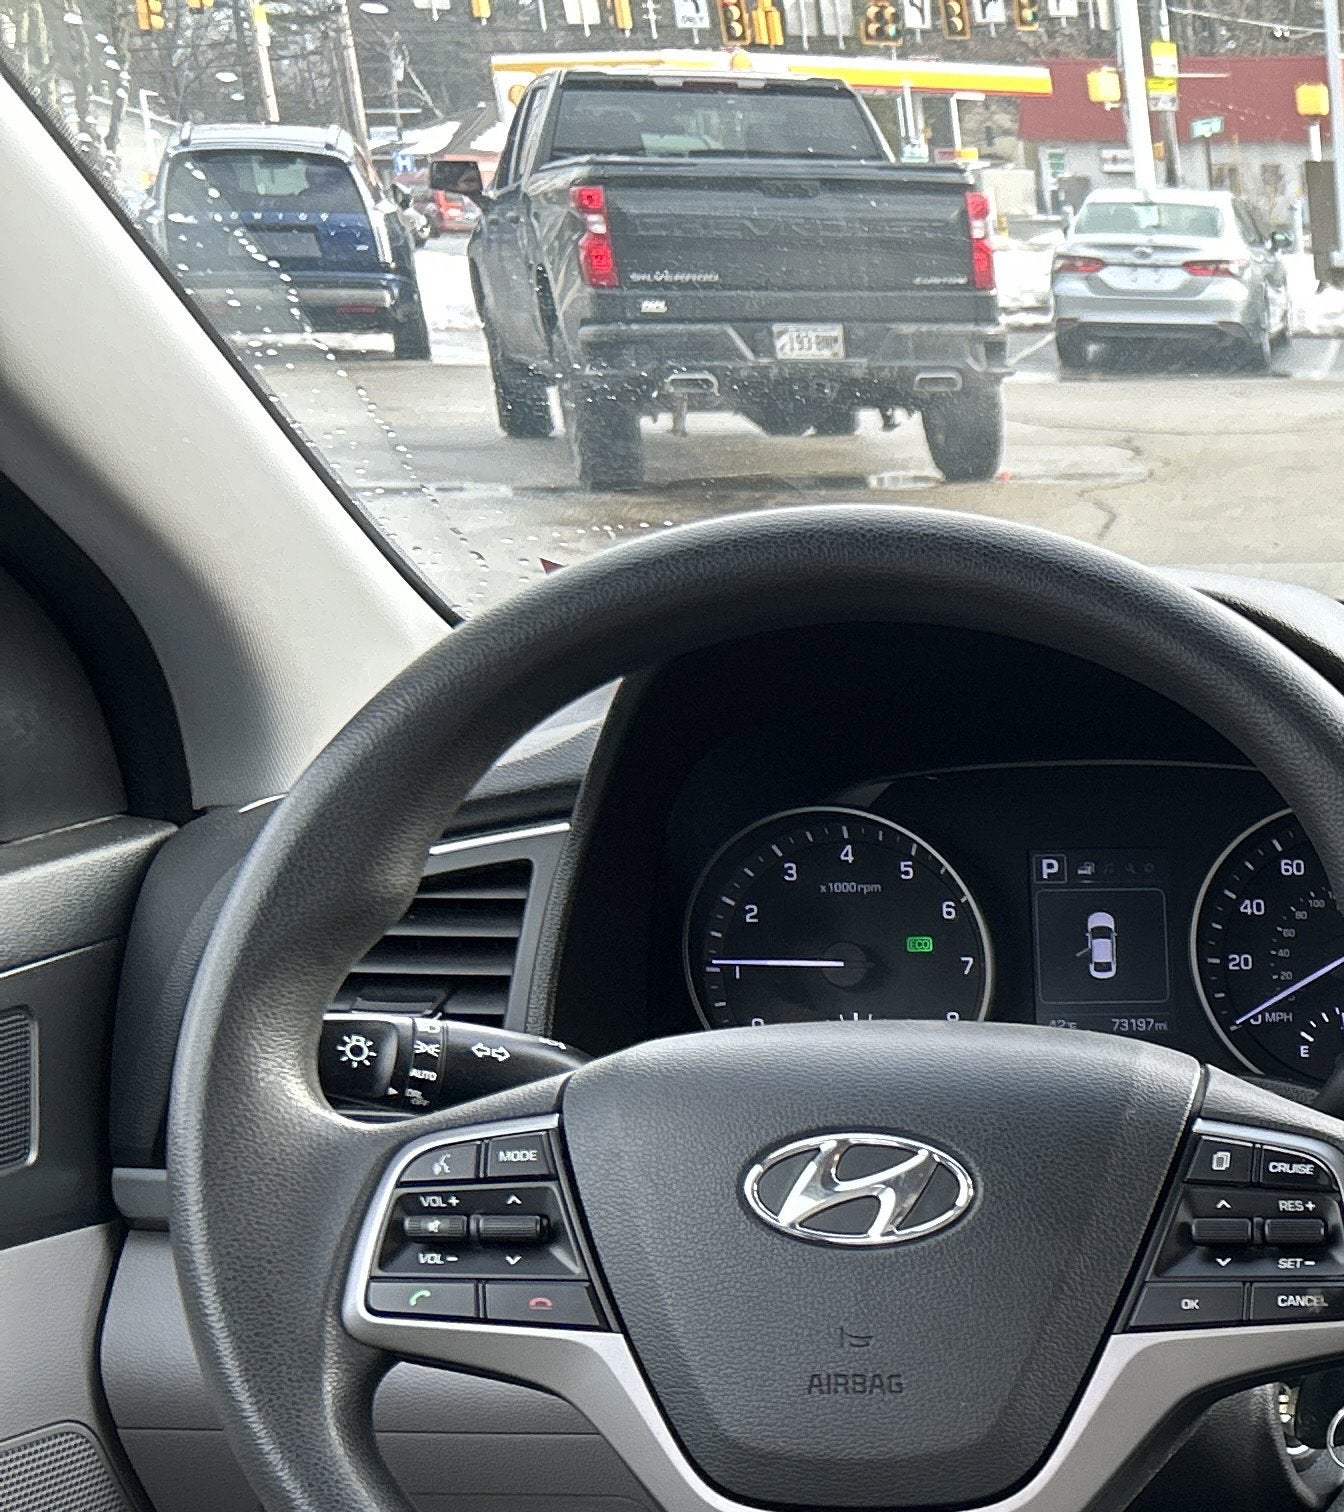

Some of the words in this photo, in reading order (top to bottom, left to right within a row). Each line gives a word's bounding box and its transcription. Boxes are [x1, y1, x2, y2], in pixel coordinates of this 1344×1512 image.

[840, 845, 854, 863] 4
[784, 863, 797, 880] 3
[900, 862, 913, 879] 5
[1041, 859, 1059, 879] P
[1280, 860, 1305, 876] 60
[942, 901, 955, 919] 6
[1240, 900, 1265, 915] 40
[1308, 899, 1326, 909] 100
[745, 905, 758, 922] 2
[1295, 911, 1308, 920] 80
[1277, 949, 1290, 958] 40
[960, 957, 974, 974] 7
[1228, 955, 1253, 970] 20
[1280, 971, 1293, 981] 20
[1265, 1012, 1293, 1022] MPH
[1300, 1045, 1310, 1058] E
[409, 1068, 438, 1082] AUTO
[499, 1150, 538, 1162] MODE
[1268, 1161, 1315, 1175] CRUISE
[1181, 1299, 1200, 1310] OK
[1277, 1295, 1329, 1308] CANCEL
[805, 1373, 904, 1395] AIRBAG
